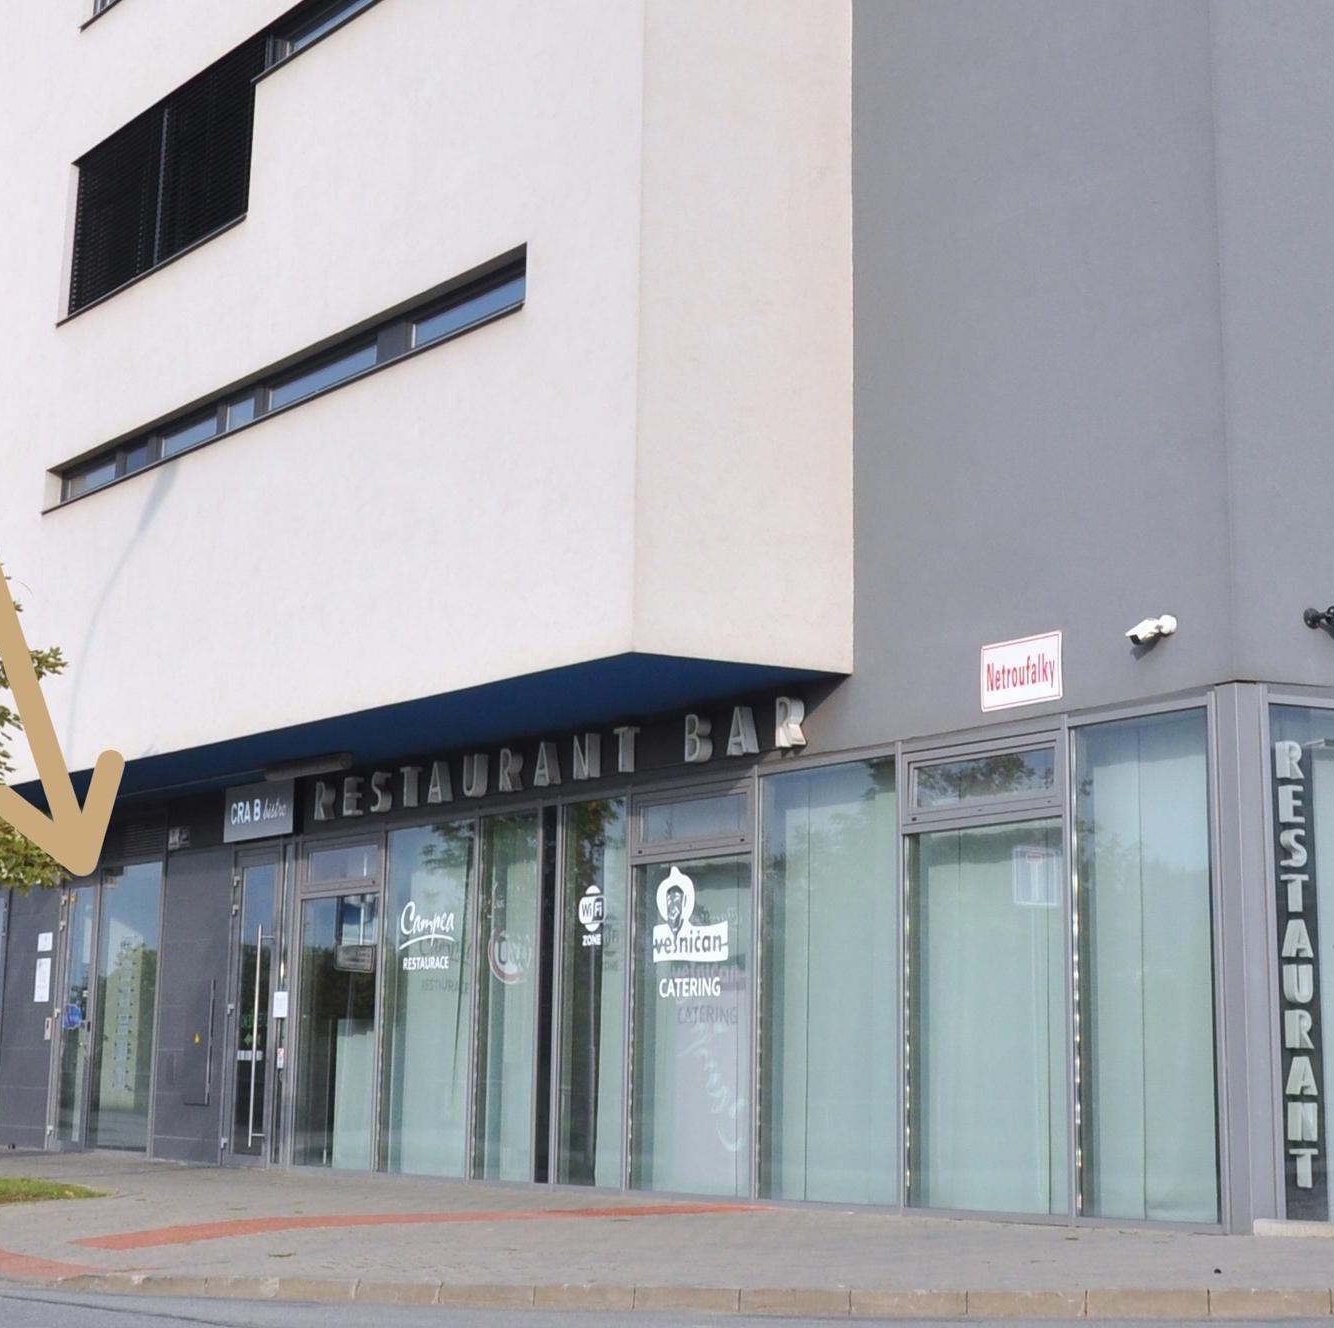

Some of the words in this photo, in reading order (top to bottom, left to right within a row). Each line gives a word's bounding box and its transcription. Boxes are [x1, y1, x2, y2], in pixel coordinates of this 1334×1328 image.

[986, 652, 1056, 693] Netroufalky
[313, 726, 641, 822] RESTAURANT
[684, 695, 807, 763] BAR
[230, 800, 251, 825] CRA
[253, 798, 262, 821] B
[401, 901, 454, 947] Campea
[582, 933, 602, 947] ZONE
[402, 956, 450, 970] RESTAURACE
[1274, 740, 1319, 1189] RESTAURANT
[658, 977, 722, 998] CATERING
